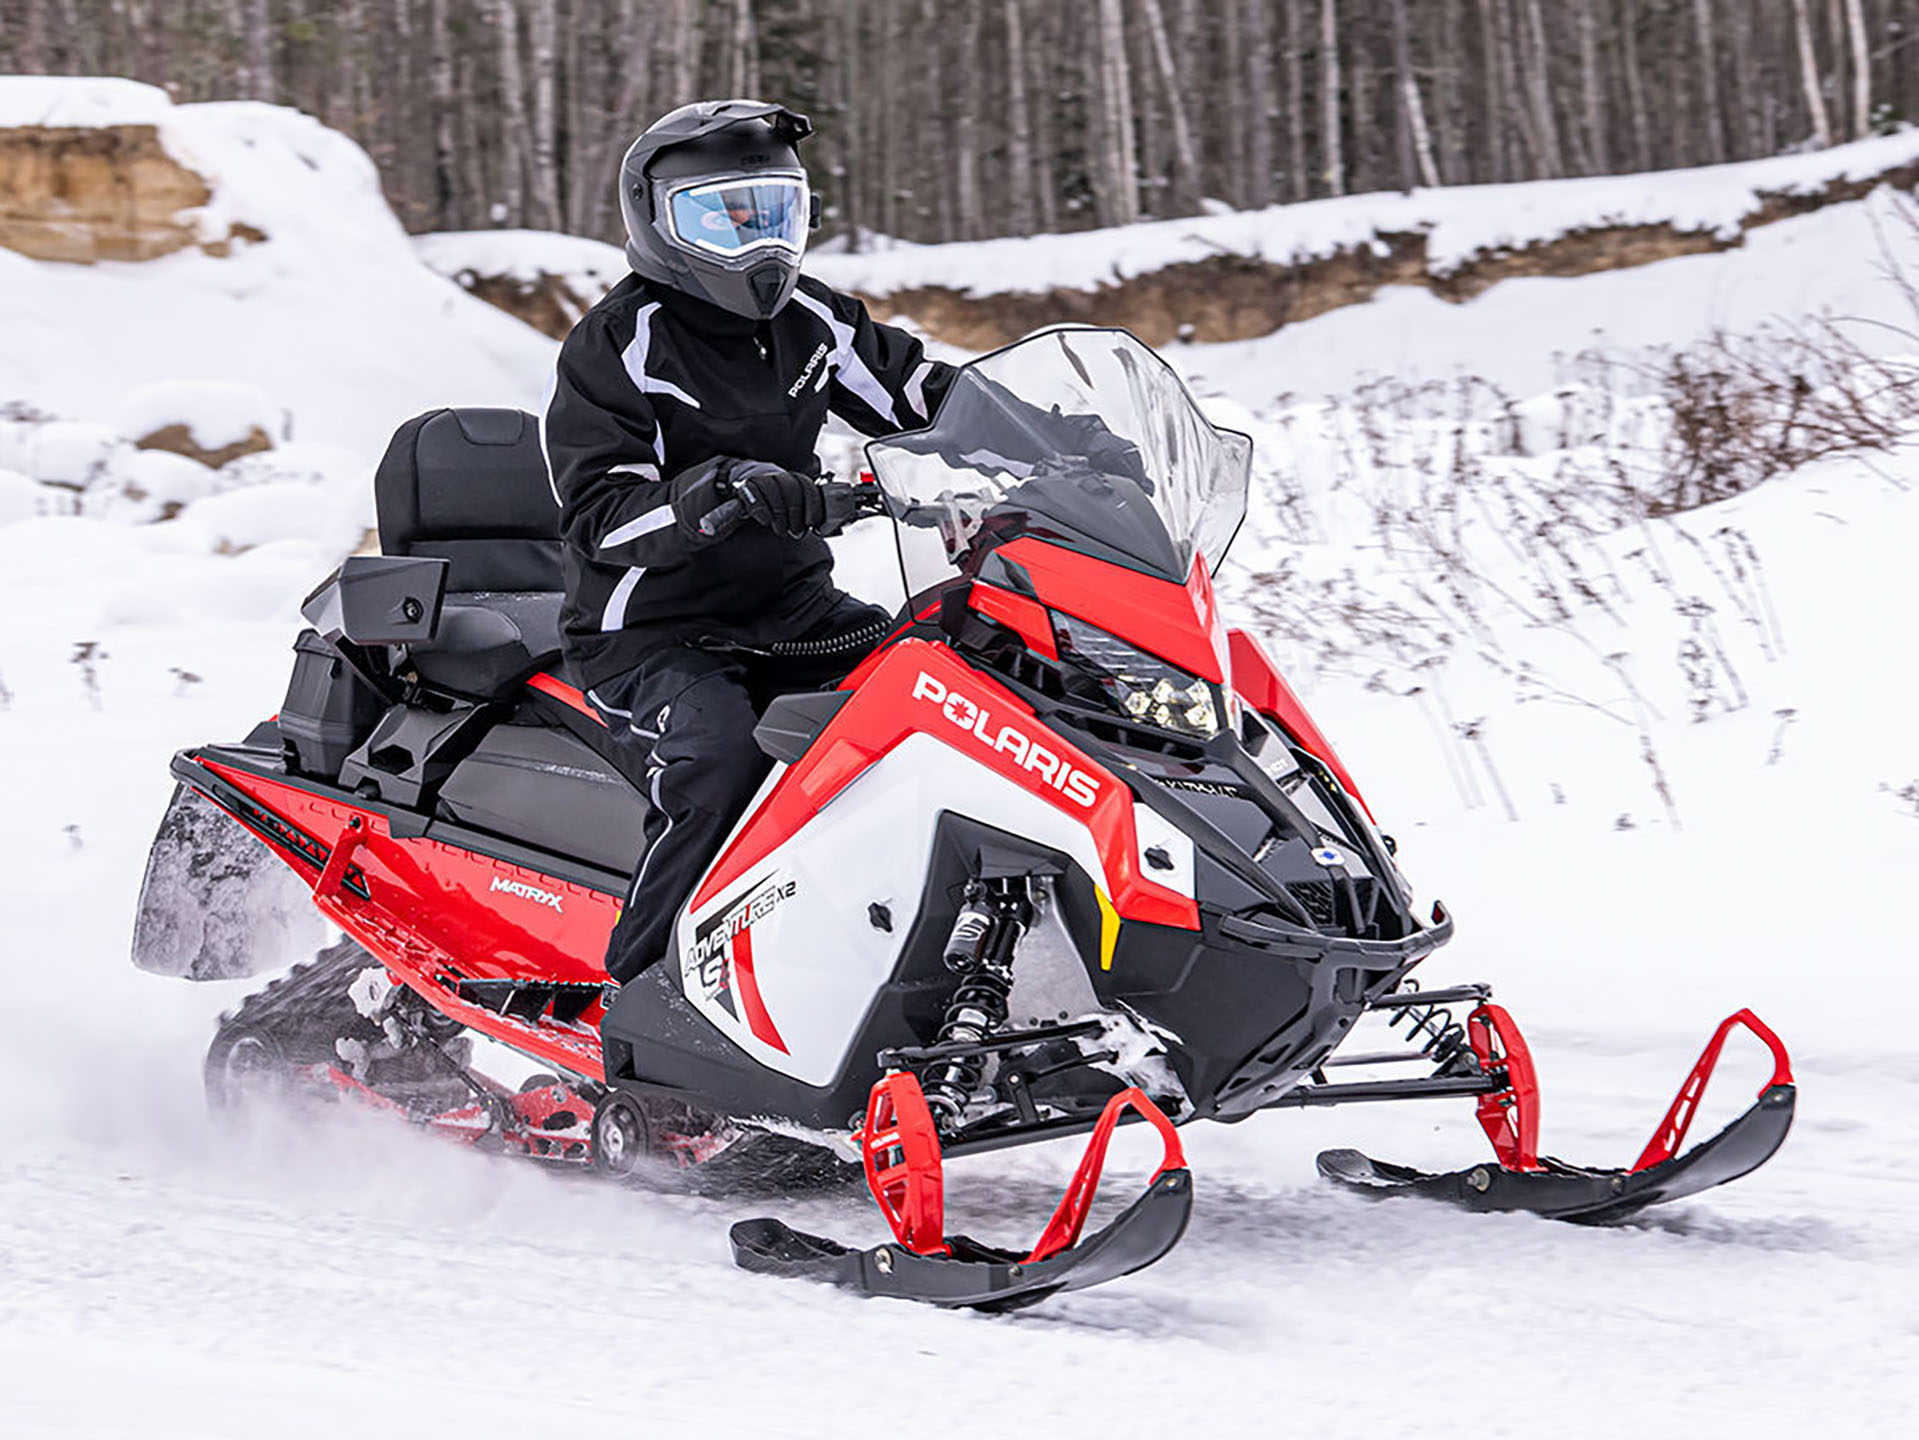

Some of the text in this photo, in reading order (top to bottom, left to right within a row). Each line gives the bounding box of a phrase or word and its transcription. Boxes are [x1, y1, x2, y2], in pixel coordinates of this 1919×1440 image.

[787, 342, 829, 398] POLARIS
[911, 670, 1101, 808] POLARIS
[489, 875, 564, 915] MATRYX
[684, 885, 776, 978] ADVENTURE
